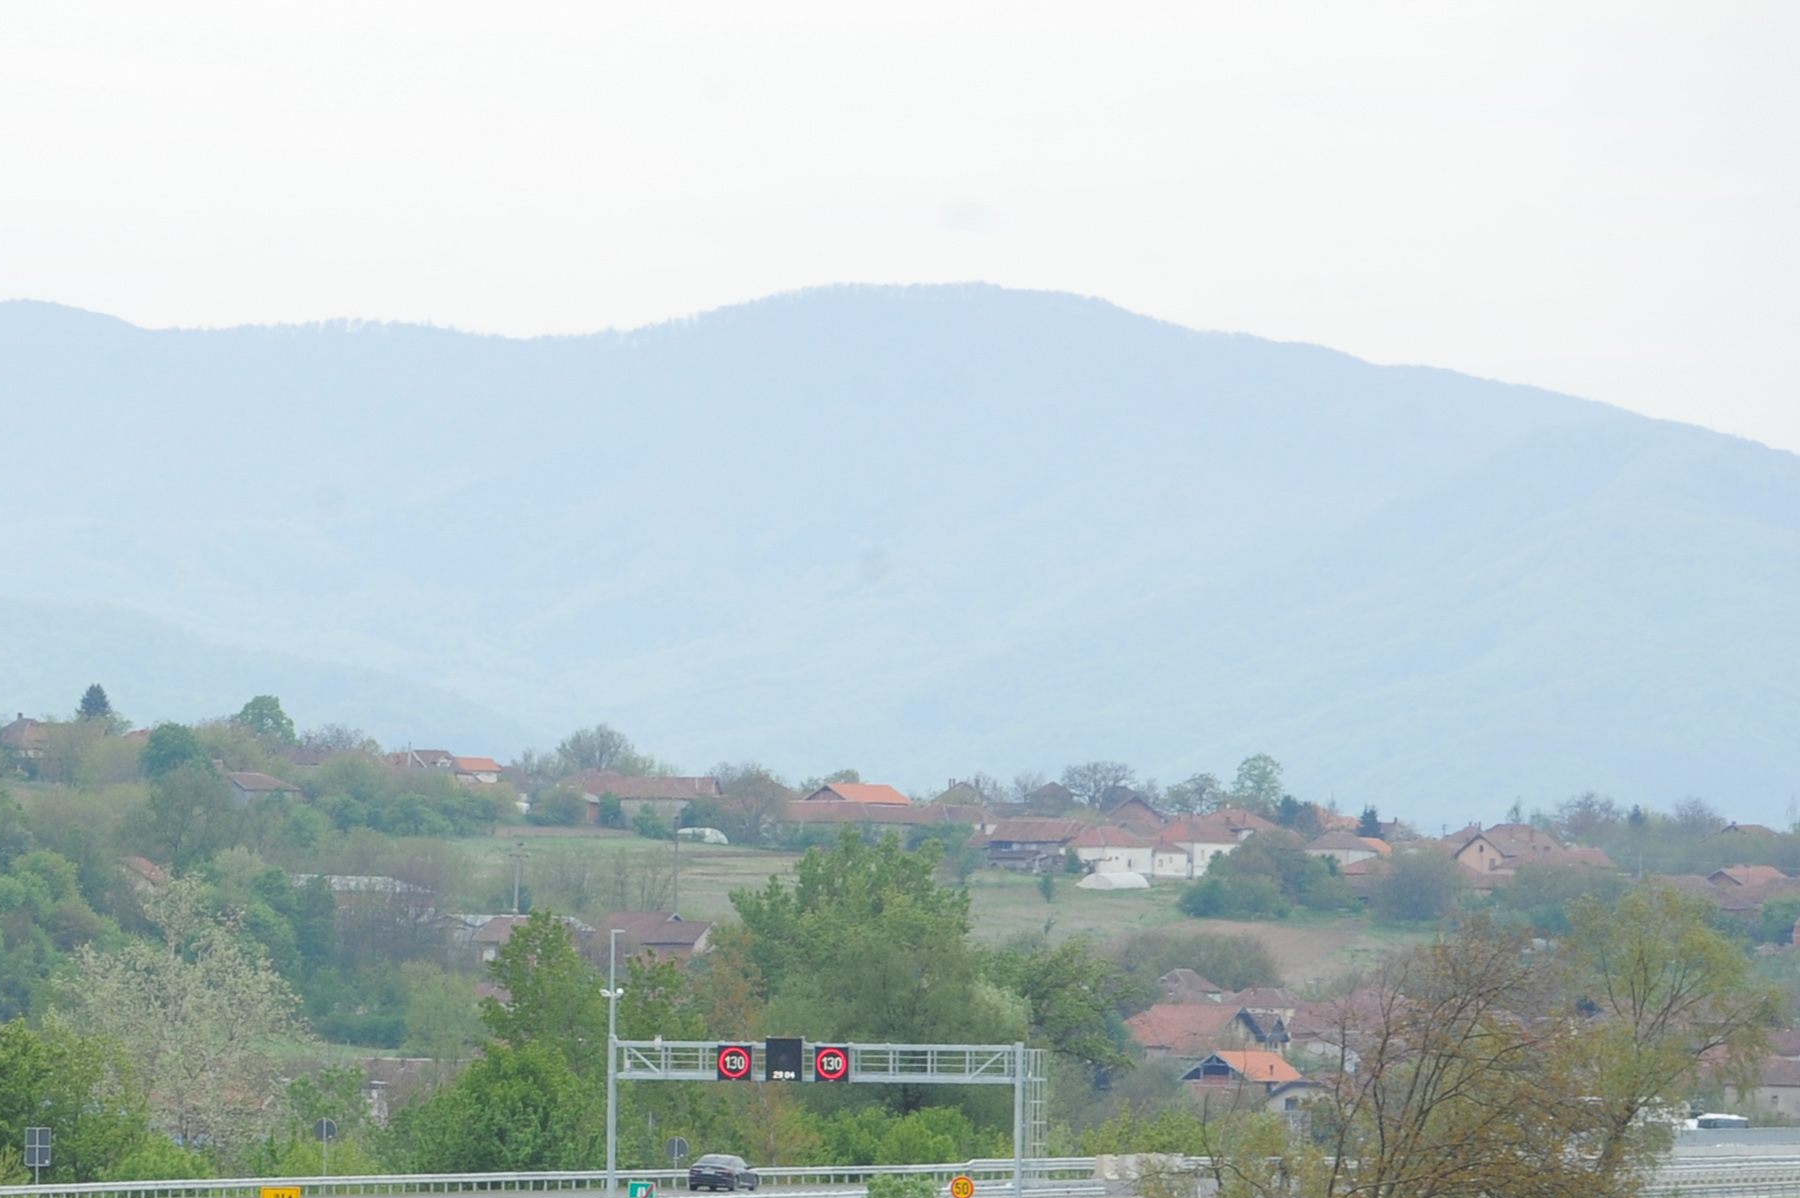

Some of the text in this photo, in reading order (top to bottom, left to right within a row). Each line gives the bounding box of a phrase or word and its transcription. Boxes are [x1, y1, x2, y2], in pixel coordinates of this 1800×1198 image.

[725, 1055, 745, 1070] 130
[821, 1056, 842, 1070] 130
[955, 1182, 969, 1195] 50
